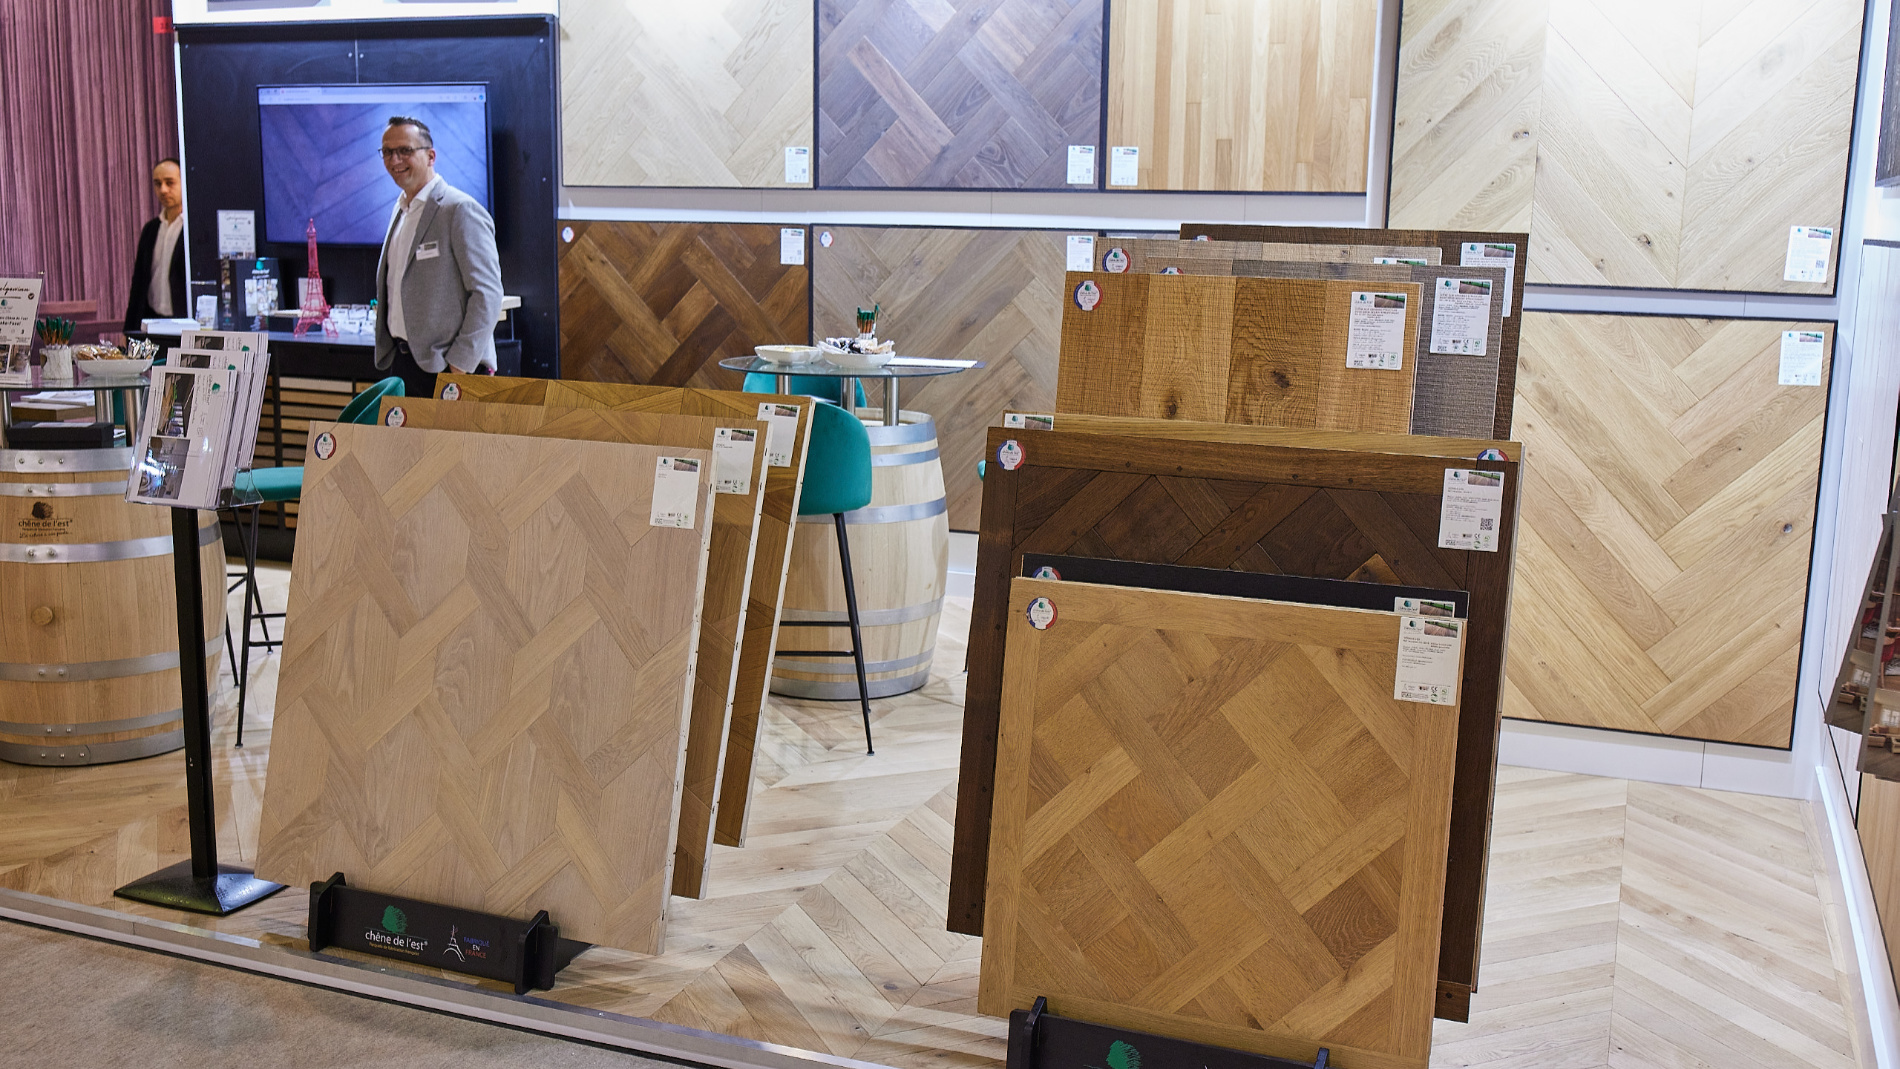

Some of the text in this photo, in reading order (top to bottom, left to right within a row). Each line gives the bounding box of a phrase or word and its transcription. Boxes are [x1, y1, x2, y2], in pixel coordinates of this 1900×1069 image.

[365, 930, 392, 945] chêne
[393, 936, 404, 947] de
[465, 949, 487, 959] FRANCE
